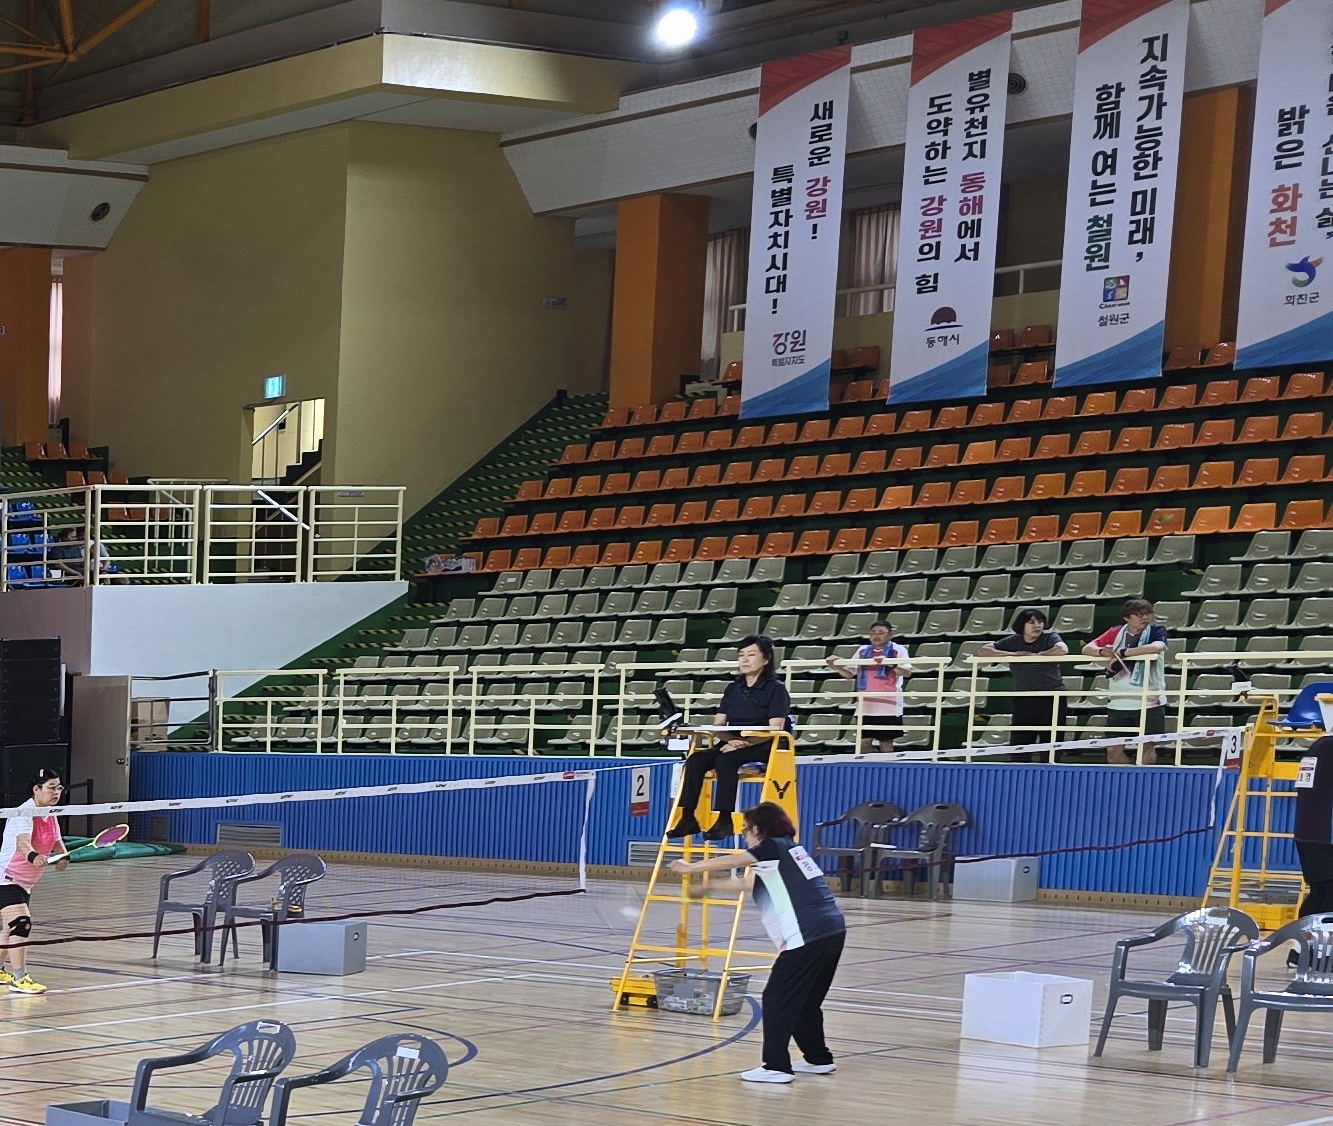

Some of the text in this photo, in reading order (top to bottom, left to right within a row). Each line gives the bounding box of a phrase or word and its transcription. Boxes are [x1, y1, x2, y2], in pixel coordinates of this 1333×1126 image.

[804, 99, 834, 240] 새로운 강원!
[915, 93, 953, 294] 도약하는 강원의 힘
[954, 68, 992, 263] 별유천지 동해에서
[1083, 81, 1126, 272] 함께 여는 철원
[1127, 33, 1169, 262] 지속가능한 미래,
[1267, 104, 1311, 248] 밝은 화천
[764, 164, 795, 315] 특별자치시대!
[772, 329, 807, 356] 강원
[925, 333, 960, 349] 동해시
[1097, 312, 1131, 327] 철원군
[636, 774, 645, 797] 2
[1230, 734, 1237, 754] 3
